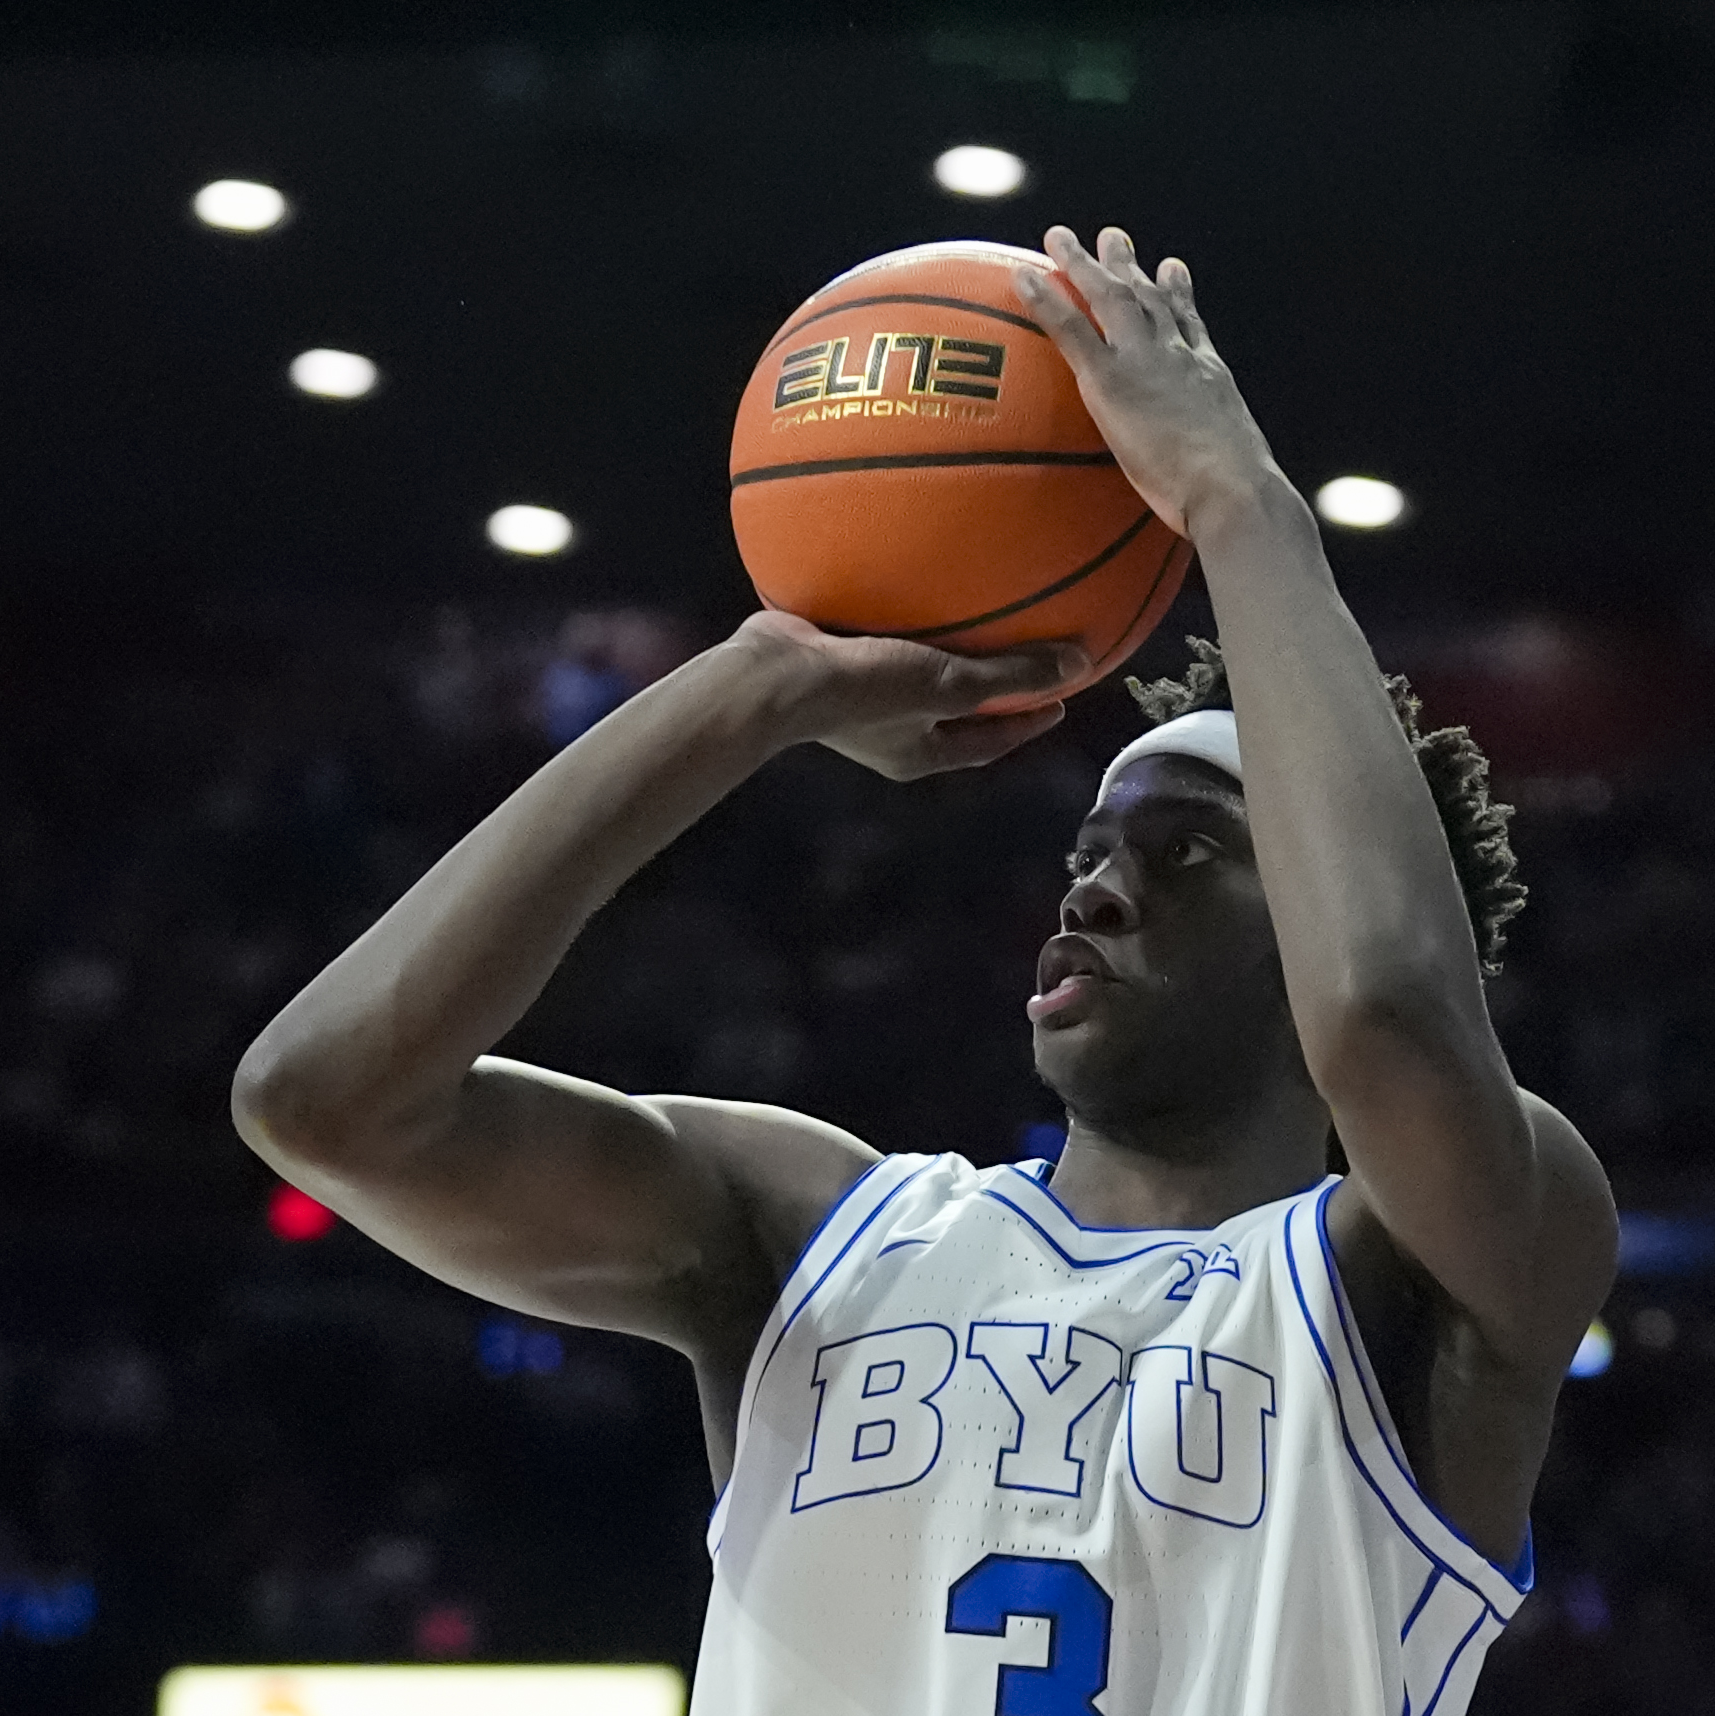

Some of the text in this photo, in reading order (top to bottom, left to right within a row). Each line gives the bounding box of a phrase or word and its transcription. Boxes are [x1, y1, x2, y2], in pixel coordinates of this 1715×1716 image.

[772, 332, 1006, 413] ELITE
[771, 399, 1002, 433] CHAMPION
[791, 1322, 1277, 1529] BYU
